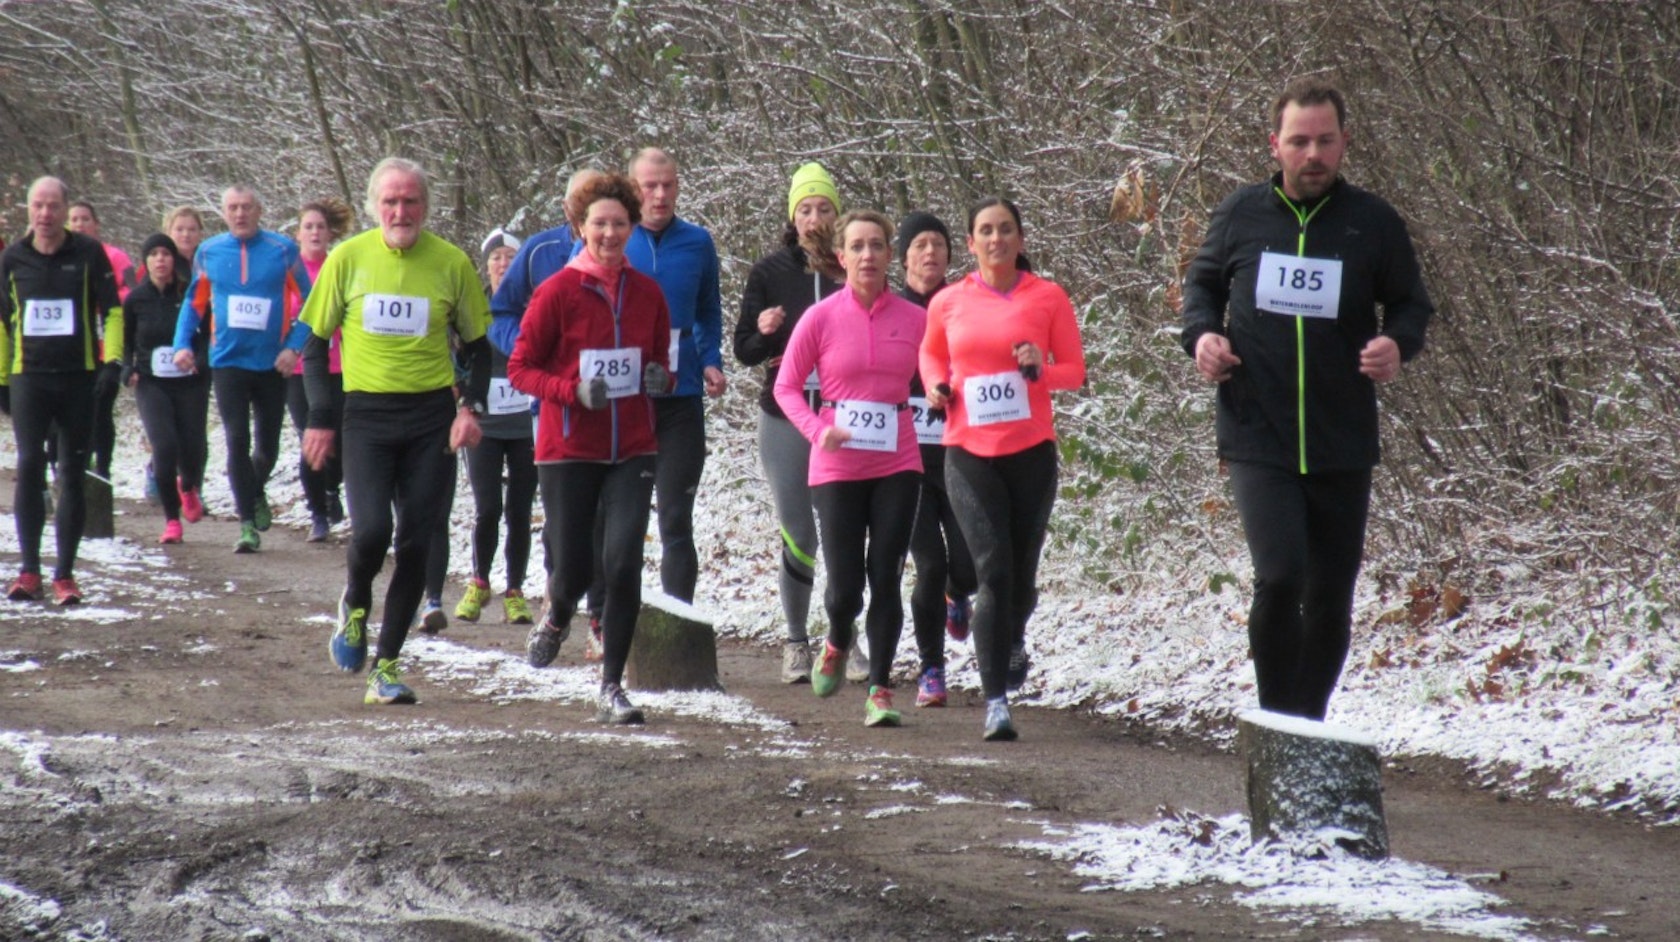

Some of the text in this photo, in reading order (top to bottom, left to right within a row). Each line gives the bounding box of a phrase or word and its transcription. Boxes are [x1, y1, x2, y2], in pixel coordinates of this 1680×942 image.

[1278, 266, 1324, 291] 185
[33, 306, 62, 320] 133
[235, 302, 262, 316] 405
[378, 300, 412, 319] 101
[594, 357, 631, 377] 285
[977, 382, 1015, 403] 306
[848, 410, 886, 430] 293
